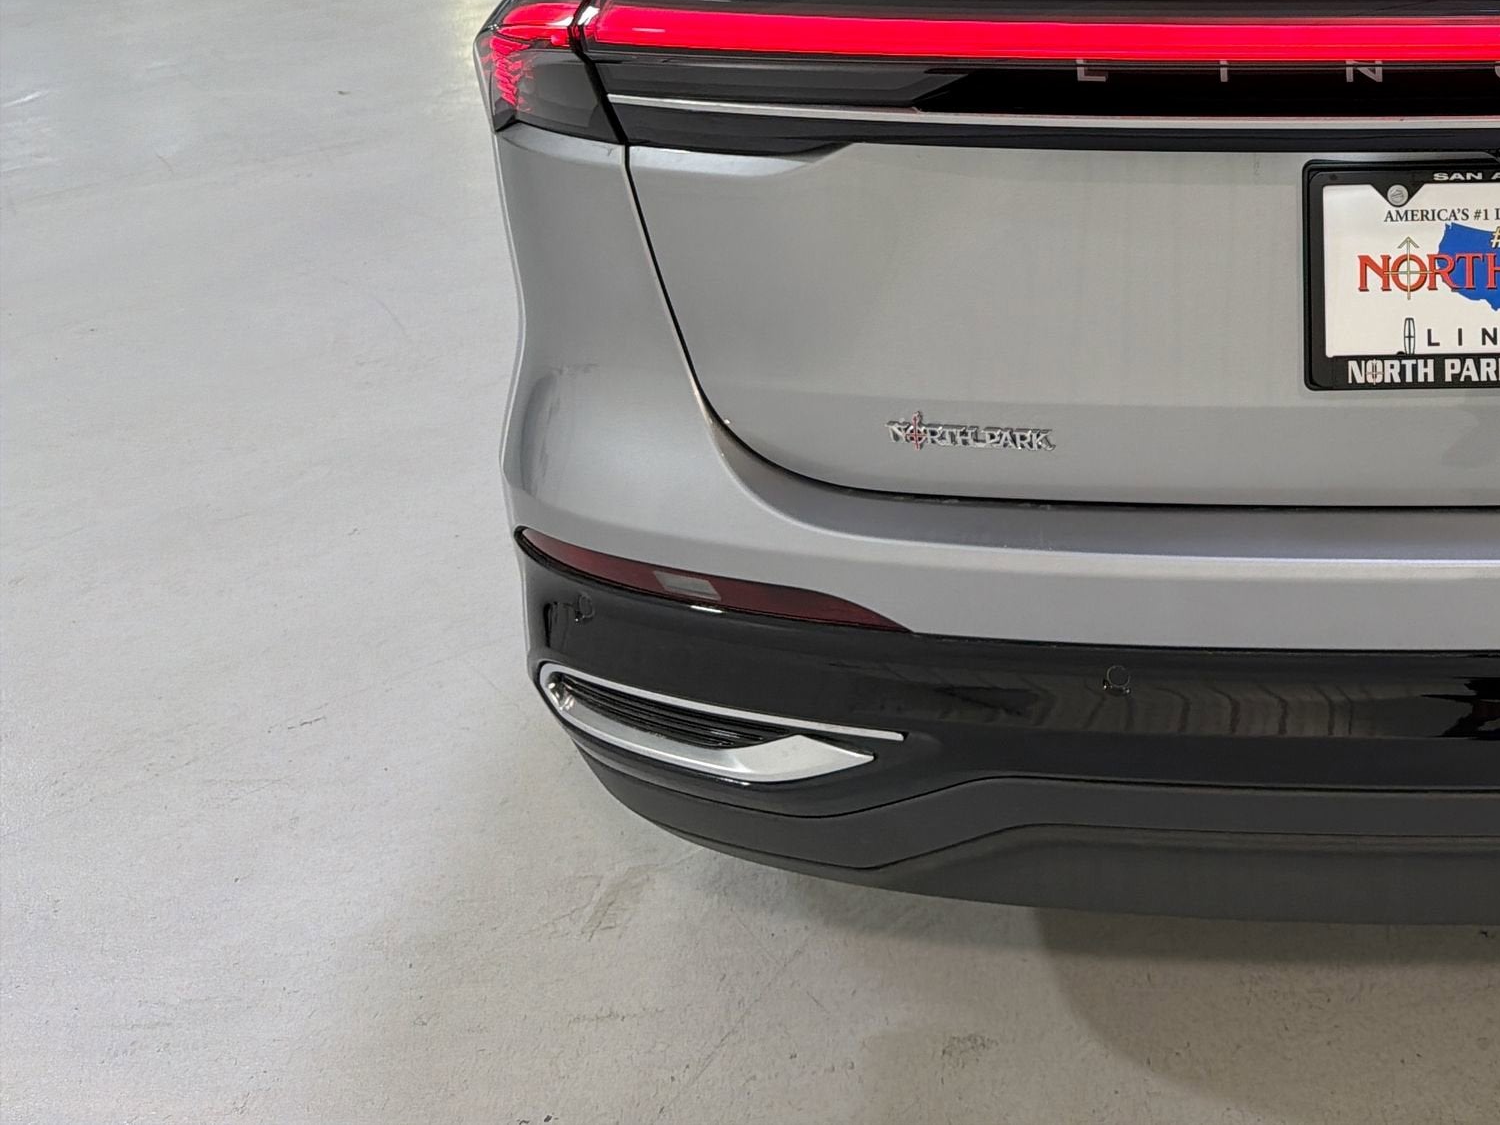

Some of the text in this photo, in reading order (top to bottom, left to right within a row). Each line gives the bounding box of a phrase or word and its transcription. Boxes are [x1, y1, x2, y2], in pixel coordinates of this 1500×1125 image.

[1433, 171, 1483, 181] SAN
[1384, 208, 1470, 223] AMERICA'S
[1473, 208, 1489, 222] #1
[1348, 359, 1434, 383] NORTH
